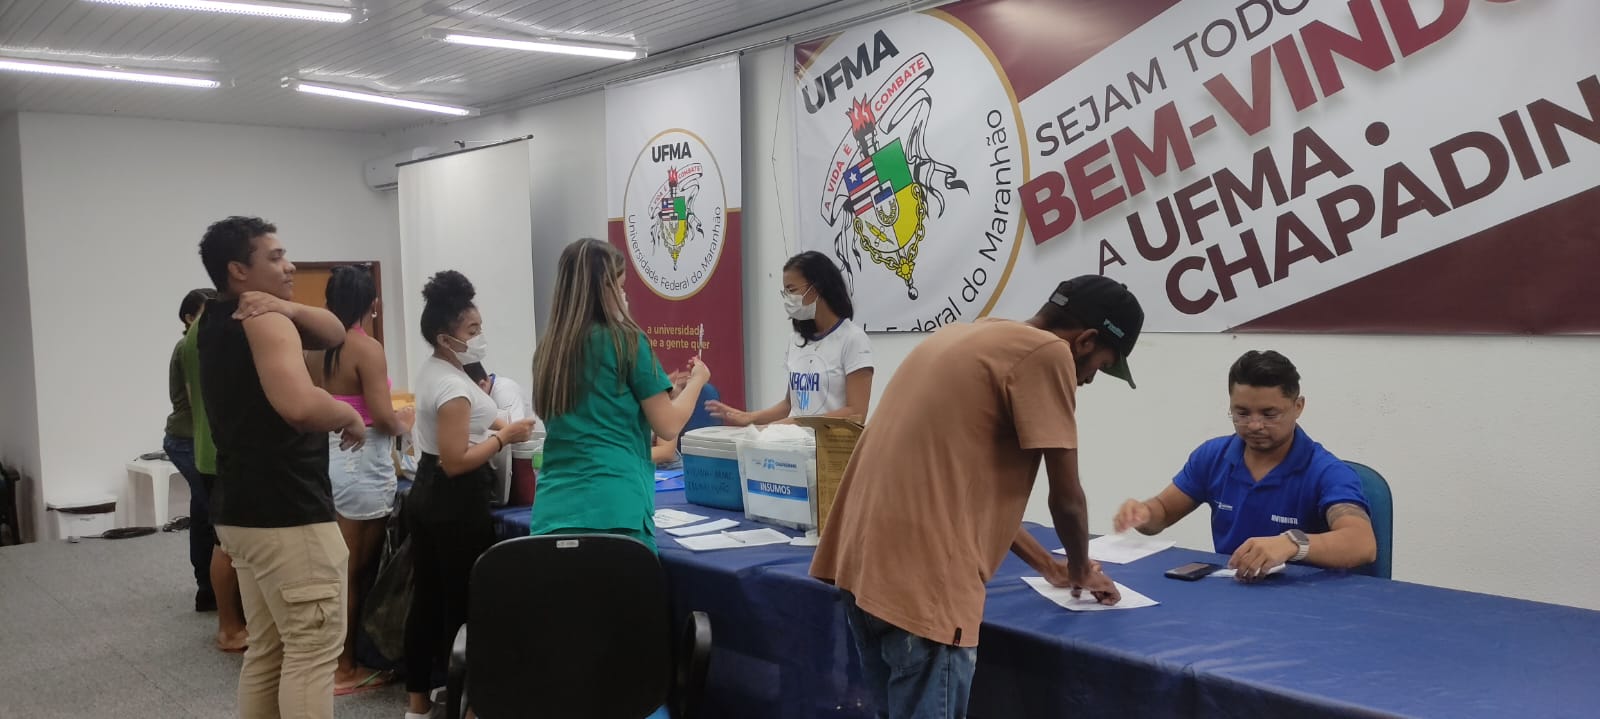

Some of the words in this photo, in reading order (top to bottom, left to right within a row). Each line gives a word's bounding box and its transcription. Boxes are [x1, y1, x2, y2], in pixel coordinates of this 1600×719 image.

[801, 29, 900, 115] UFMA
[874, 57, 926, 112] COMBATE
[1018, 0, 1518, 246] BEM-VIND
[1036, 56, 1168, 157] SEJAM
[651, 141, 692, 163] UFMA
[827, 160, 845, 193] VIDA
[843, 143, 853, 155] É
[824, 201, 832, 212] A
[886, 296, 962, 332] deral
[962, 267, 987, 303] do
[980, 109, 1012, 262] Maranhão
[1099, 238, 1127, 275] A
[1126, 125, 1354, 262] UFMA
[1165, 74, 1600, 315] CHAPADIN
[628, 214, 659, 284] Universidade
[661, 276, 690, 291] Federal
[690, 270, 703, 284] do
[701, 206, 721, 272] Maranhão
[647, 326, 652, 334] a
[660, 339, 664, 348] a
[666, 338, 689, 350] gente
[760, 482, 791, 495] INSUMOS
